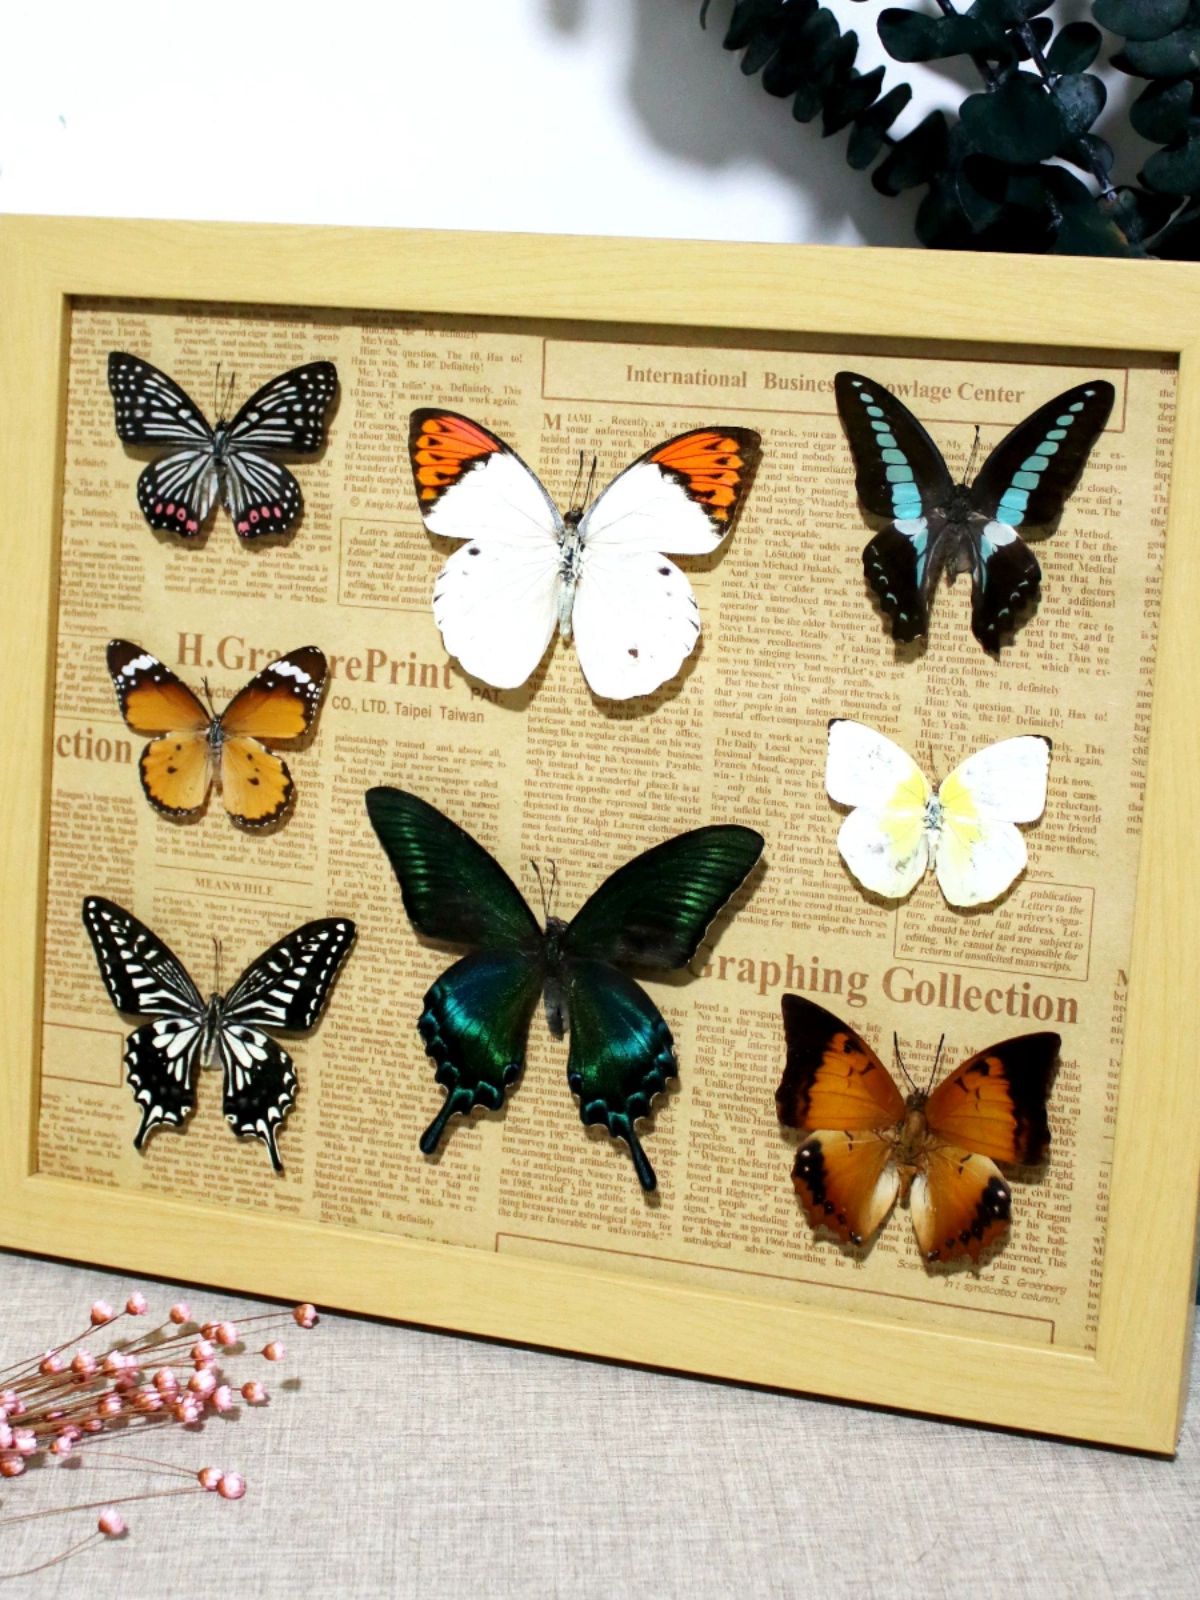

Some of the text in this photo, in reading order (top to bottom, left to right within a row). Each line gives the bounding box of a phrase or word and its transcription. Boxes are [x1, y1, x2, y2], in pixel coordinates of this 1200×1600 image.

[627, 364, 1025, 404] International Busines owlage Center
[802, 430, 819, 440] you
[821, 431, 837, 439] can
[1088, 484, 1121, 495] closely.
[1103, 508, 1121, 517] The
[1074, 528, 1113, 540] Method.
[1103, 543, 1118, 552] the
[1103, 554, 1118, 563] the
[763, 561, 801, 572] Michael
[1079, 562, 1116, 574] Medical
[755, 570, 772, 581] you
[778, 572, 804, 581] never
[1062, 584, 1116, 597] by doctors
[1043, 606, 1071, 616] would
[1055, 619, 1071, 628] the
[1084, 633, 1102, 643] and
[1027, 639, 1045, 649] had
[822, 685, 849, 696] about
[362, 698, 390, 715] LTD.
[394, 702, 432, 721] Taipei
[440, 706, 485, 723] Taiwan
[471, 687, 504, 704] PAT.
[1024, 705, 1041, 715] The
[196, 878, 274, 896] MEANWHILE
[1030, 890, 1082, 904] publication
[927, 924, 957, 935] should
[971, 929, 994, 941] brief
[882, 966, 1079, 1024] Gollection
